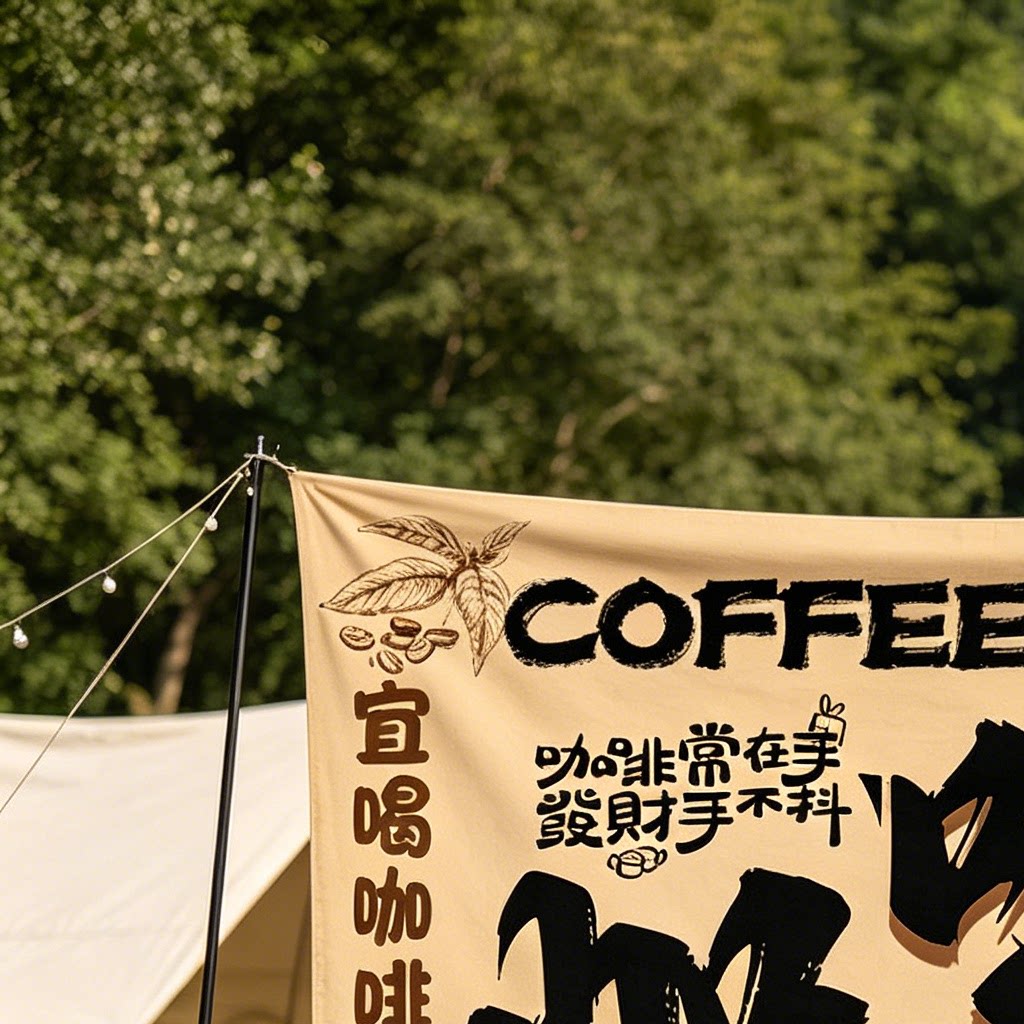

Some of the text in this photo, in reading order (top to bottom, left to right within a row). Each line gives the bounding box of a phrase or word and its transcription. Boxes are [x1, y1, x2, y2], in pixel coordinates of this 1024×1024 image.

[535, 721, 841, 788] 咖啡常在手
